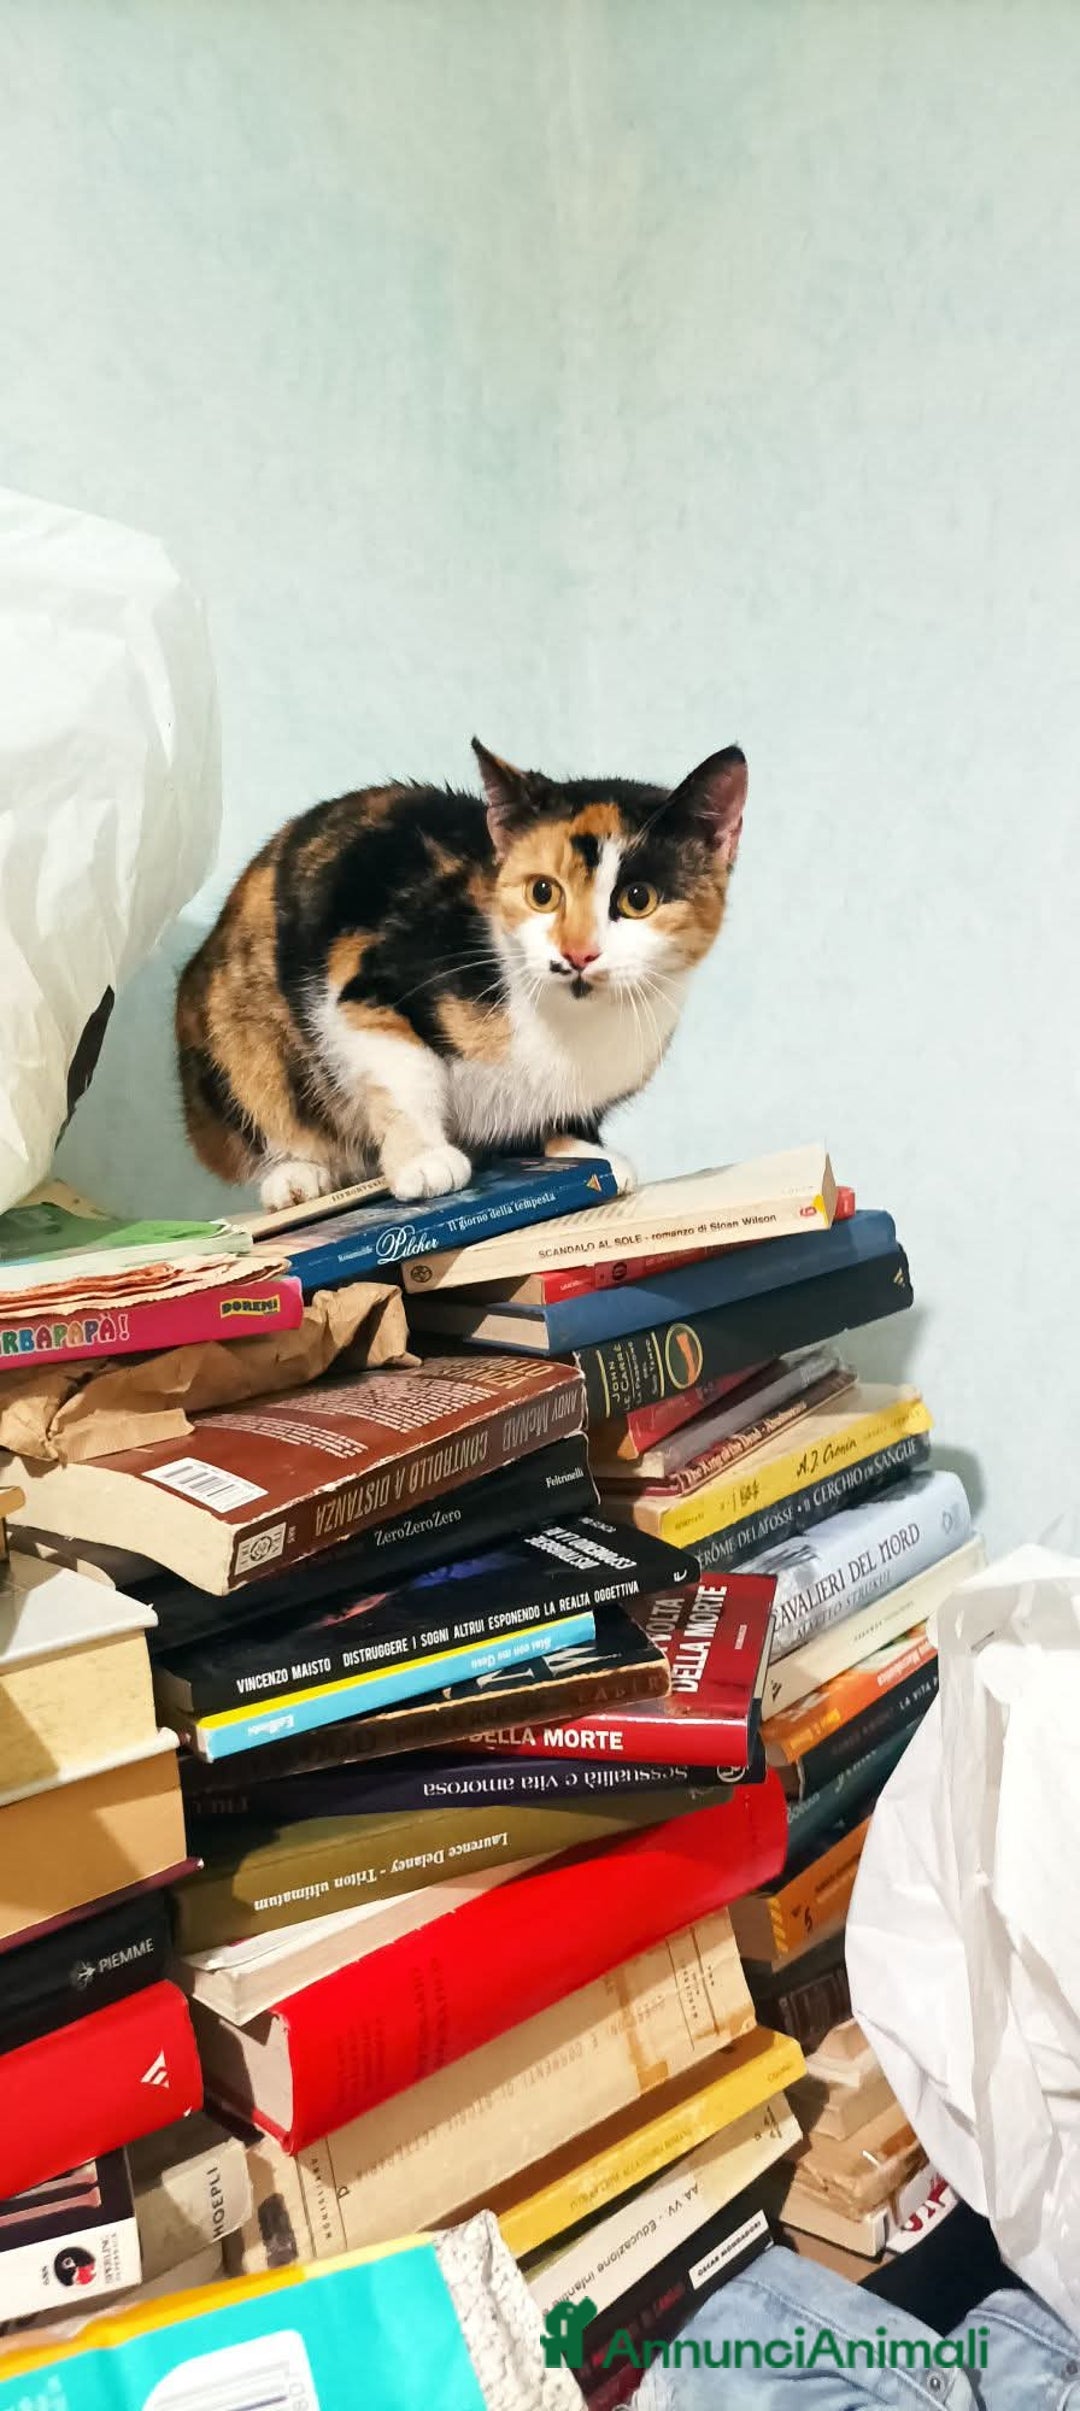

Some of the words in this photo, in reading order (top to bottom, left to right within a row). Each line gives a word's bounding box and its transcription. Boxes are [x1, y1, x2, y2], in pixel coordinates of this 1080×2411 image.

[458, 1211, 488, 1231] giorno
[490, 1203, 514, 1221] della
[514, 1191, 557, 1213] tempesta
[375, 1224, 440, 1265] Pilcher
[538, 1241, 596, 1259] SCANDALO
[598, 1239, 613, 1251] AL
[613, 1234, 643, 1247] SOLE
[651, 1226, 695, 1242] romanzo
[697, 1223, 708, 1234] di
[709, 1218, 740, 1232] Sloan
[741, 1213, 777, 1228] Wilson
[608, 1360, 621, 1403] JOHN
[551, 1387, 580, 1421] ANDY
[409, 1430, 489, 1493] CONTROLLO
[822, 1438, 857, 1465] Cronin
[394, 1467, 406, 1498] A
[545, 1467, 585, 1489] Feltrinelli
[736, 1506, 793, 1549] DELAFOSSE
[812, 1467, 863, 1506] CERCHIO
[873, 1438, 917, 1472] SANGUE
[314, 1475, 390, 1537] DISTANZA
[374, 1508, 463, 1547] ZeroZeroZero
[848, 1551, 878, 1587] DEL
[878, 1522, 921, 1566] NORD
[645, 1597, 685, 1642] VOLTA
[684, 1584, 728, 1642] MORTE
[236, 1668, 289, 1694] VINCENZO
[291, 1657, 332, 1681] MAISTO
[342, 1637, 409, 1668] DISTRUGGERE
[412, 1635, 418, 1650] I
[420, 1627, 450, 1648] SOGNI
[453, 1618, 486, 1640] ALTRUI
[488, 1605, 541, 1632] ESPONENDO
[543, 1601, 556, 1616] LA
[593, 1580, 640, 1604] OGGETTIVA
[671, 1641, 712, 1694] DELLA
[468, 1726, 536, 1747] DELLA
[543, 1728, 625, 1751] MORTE
[423, 1777, 515, 1797] amorosa
[521, 1775, 559, 1791] vita
[565, 1774, 578, 1787] e
[584, 1764, 688, 1791] Sessualità
[390, 1849, 445, 1875] Delaney
[447, 1831, 509, 1858] Laurence
[253, 1880, 330, 1911] ultimatum
[333, 1867, 378, 1889] Triton
[98, 1937, 155, 1973] PIEMME
[206, 2166, 226, 2239] HOEPLI
[596, 2218, 658, 2272] Educazione
[697, 2255, 720, 2277] OSCAR
[720, 2220, 762, 2258] MONDADORI
